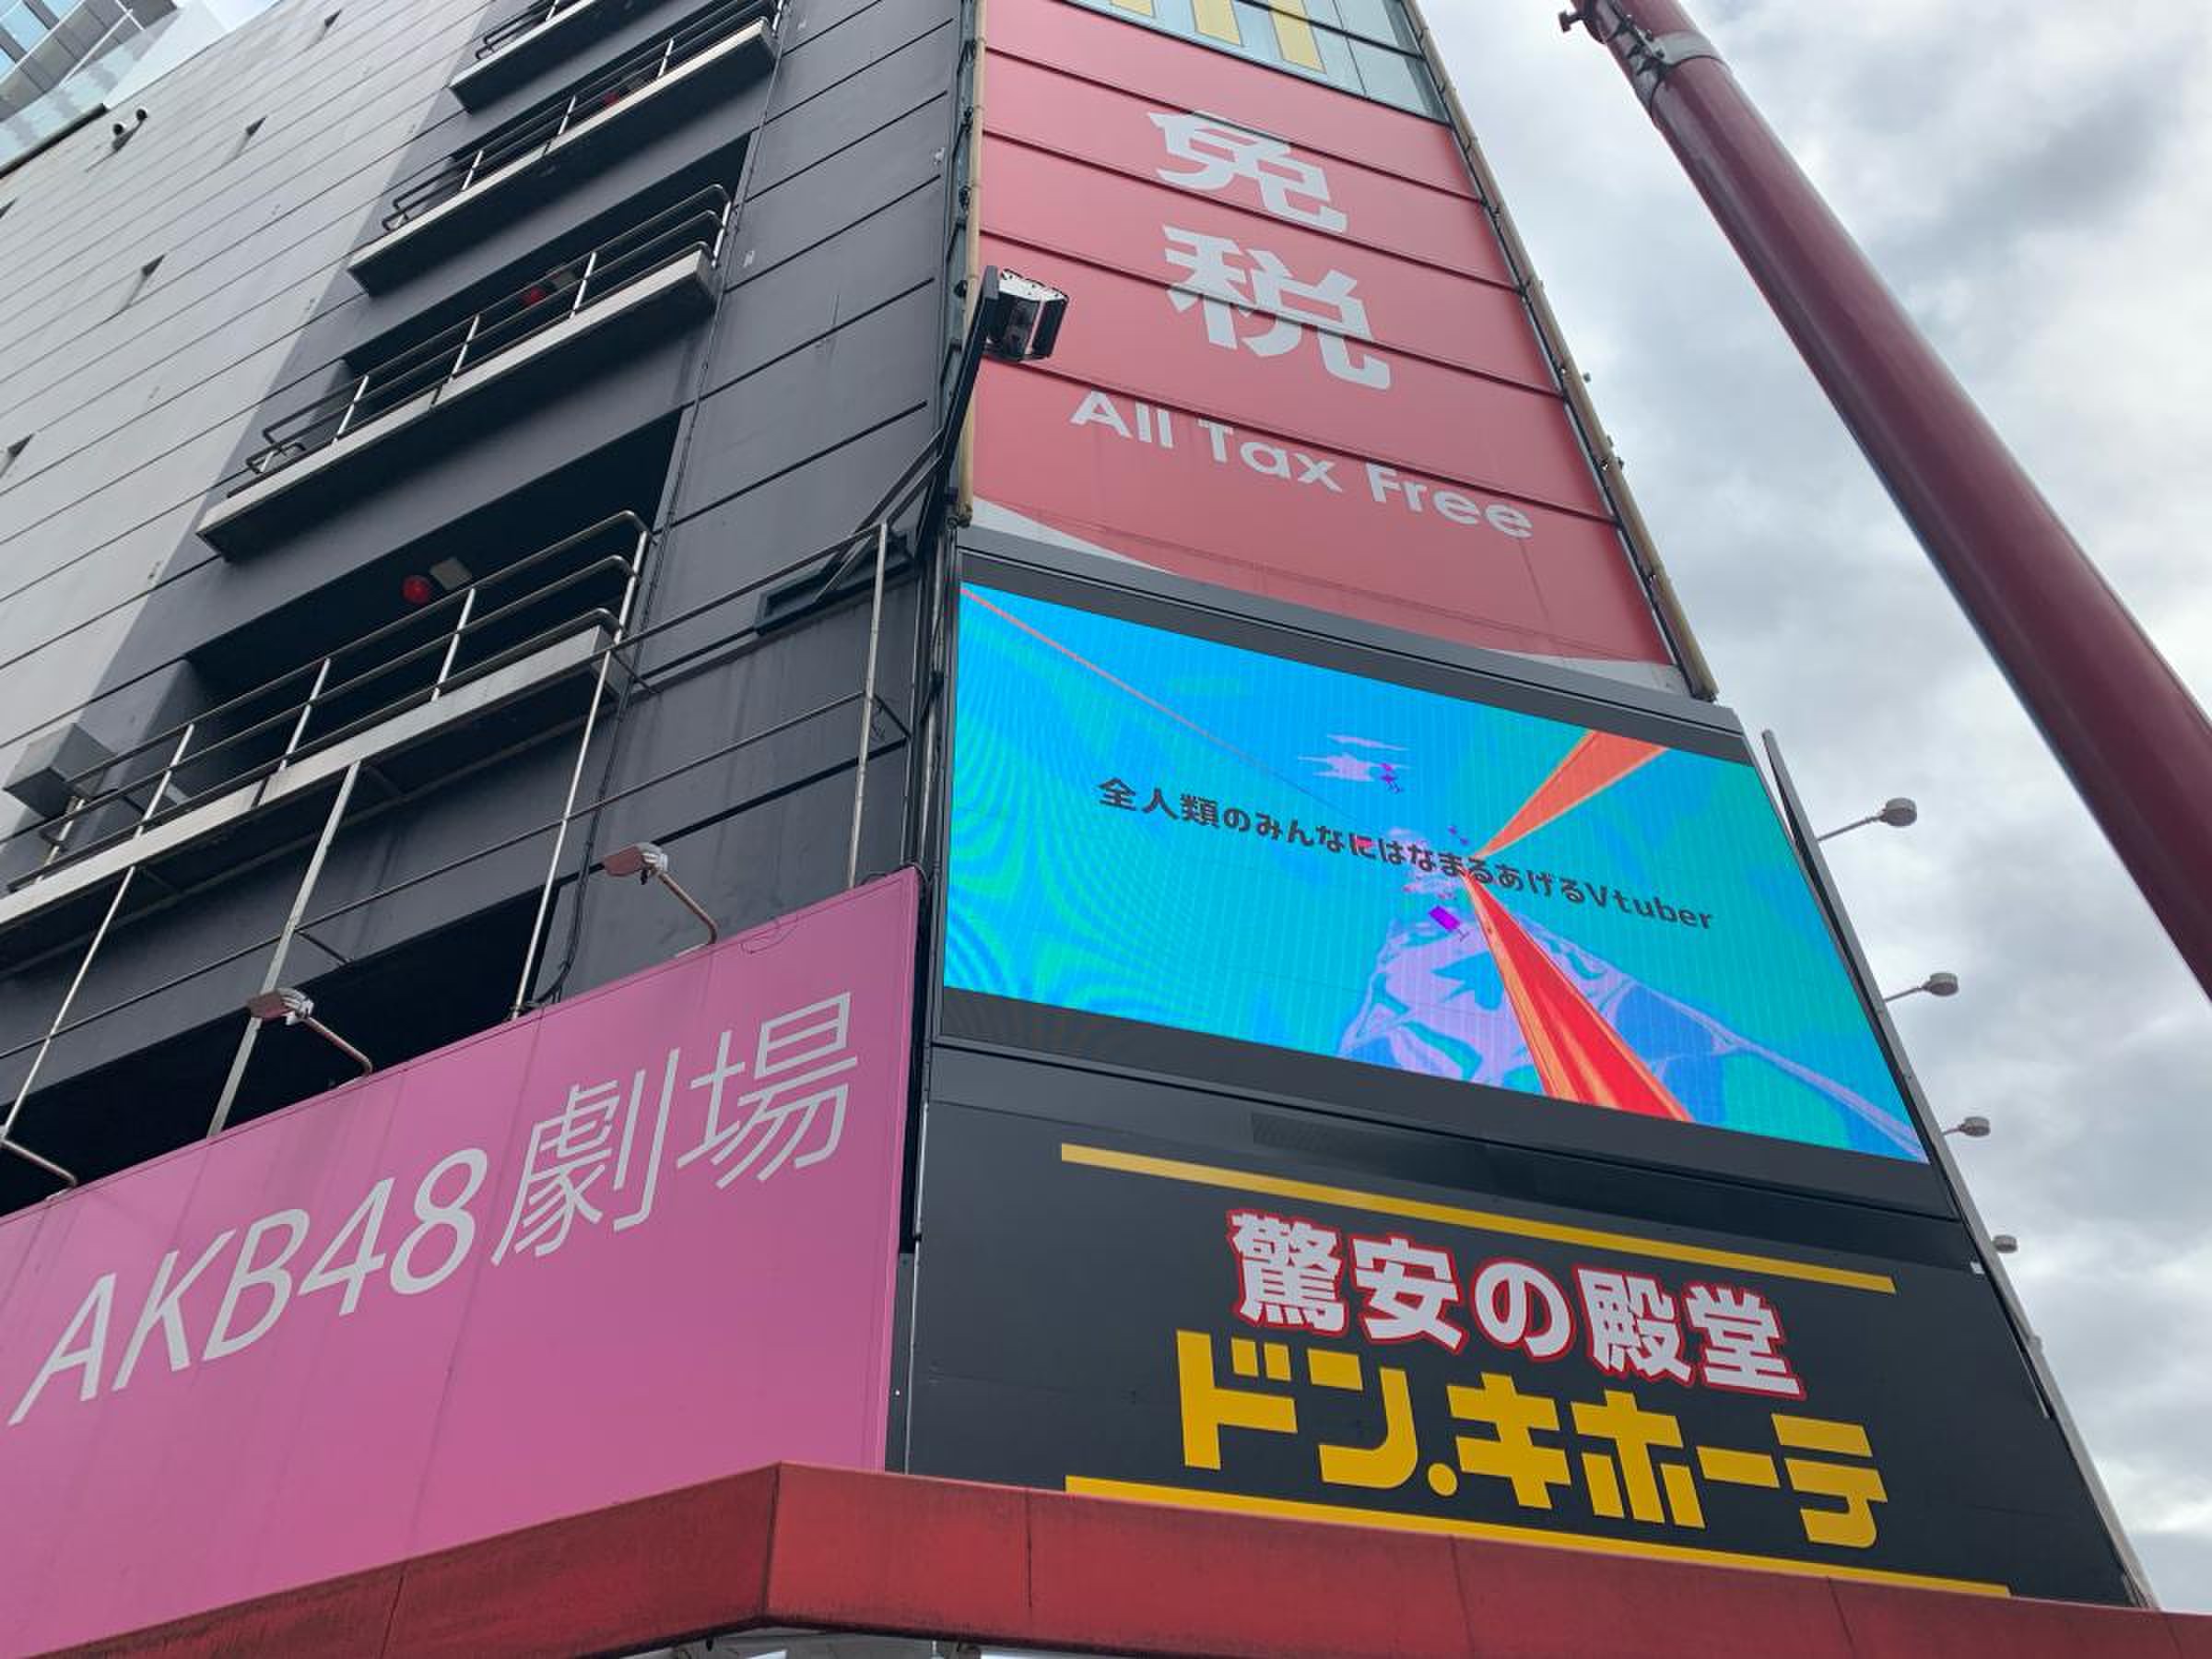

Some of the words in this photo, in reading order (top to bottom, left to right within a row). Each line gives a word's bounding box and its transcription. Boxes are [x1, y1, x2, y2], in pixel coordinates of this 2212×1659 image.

[1147, 110, 1392, 391] 免税
[1071, 391, 1175, 448] All
[1198, 420, 1344, 492] Tax
[1366, 464, 1534, 539] Free
[8, 991, 859, 1426] AKB48劇場
[1229, 1210, 1805, 1399] 驚安の殿堂
